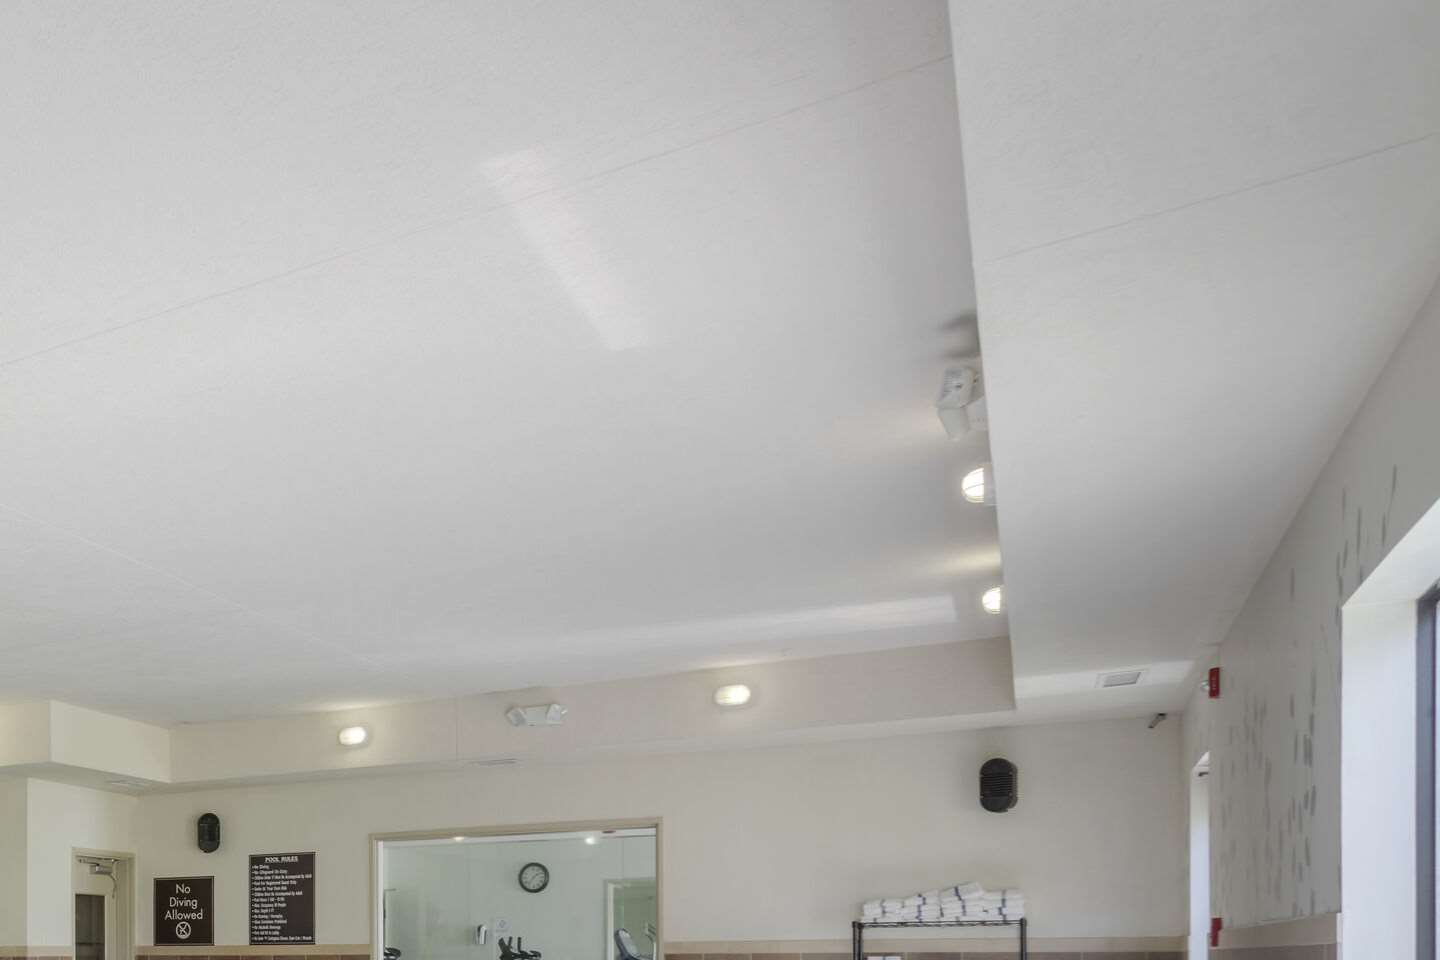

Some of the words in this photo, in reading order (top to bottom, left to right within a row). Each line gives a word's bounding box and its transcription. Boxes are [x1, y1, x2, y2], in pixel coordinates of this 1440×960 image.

[175, 883, 191, 894] No
[169, 896, 198, 910] Diving
[164, 908, 203, 920] Allowed
